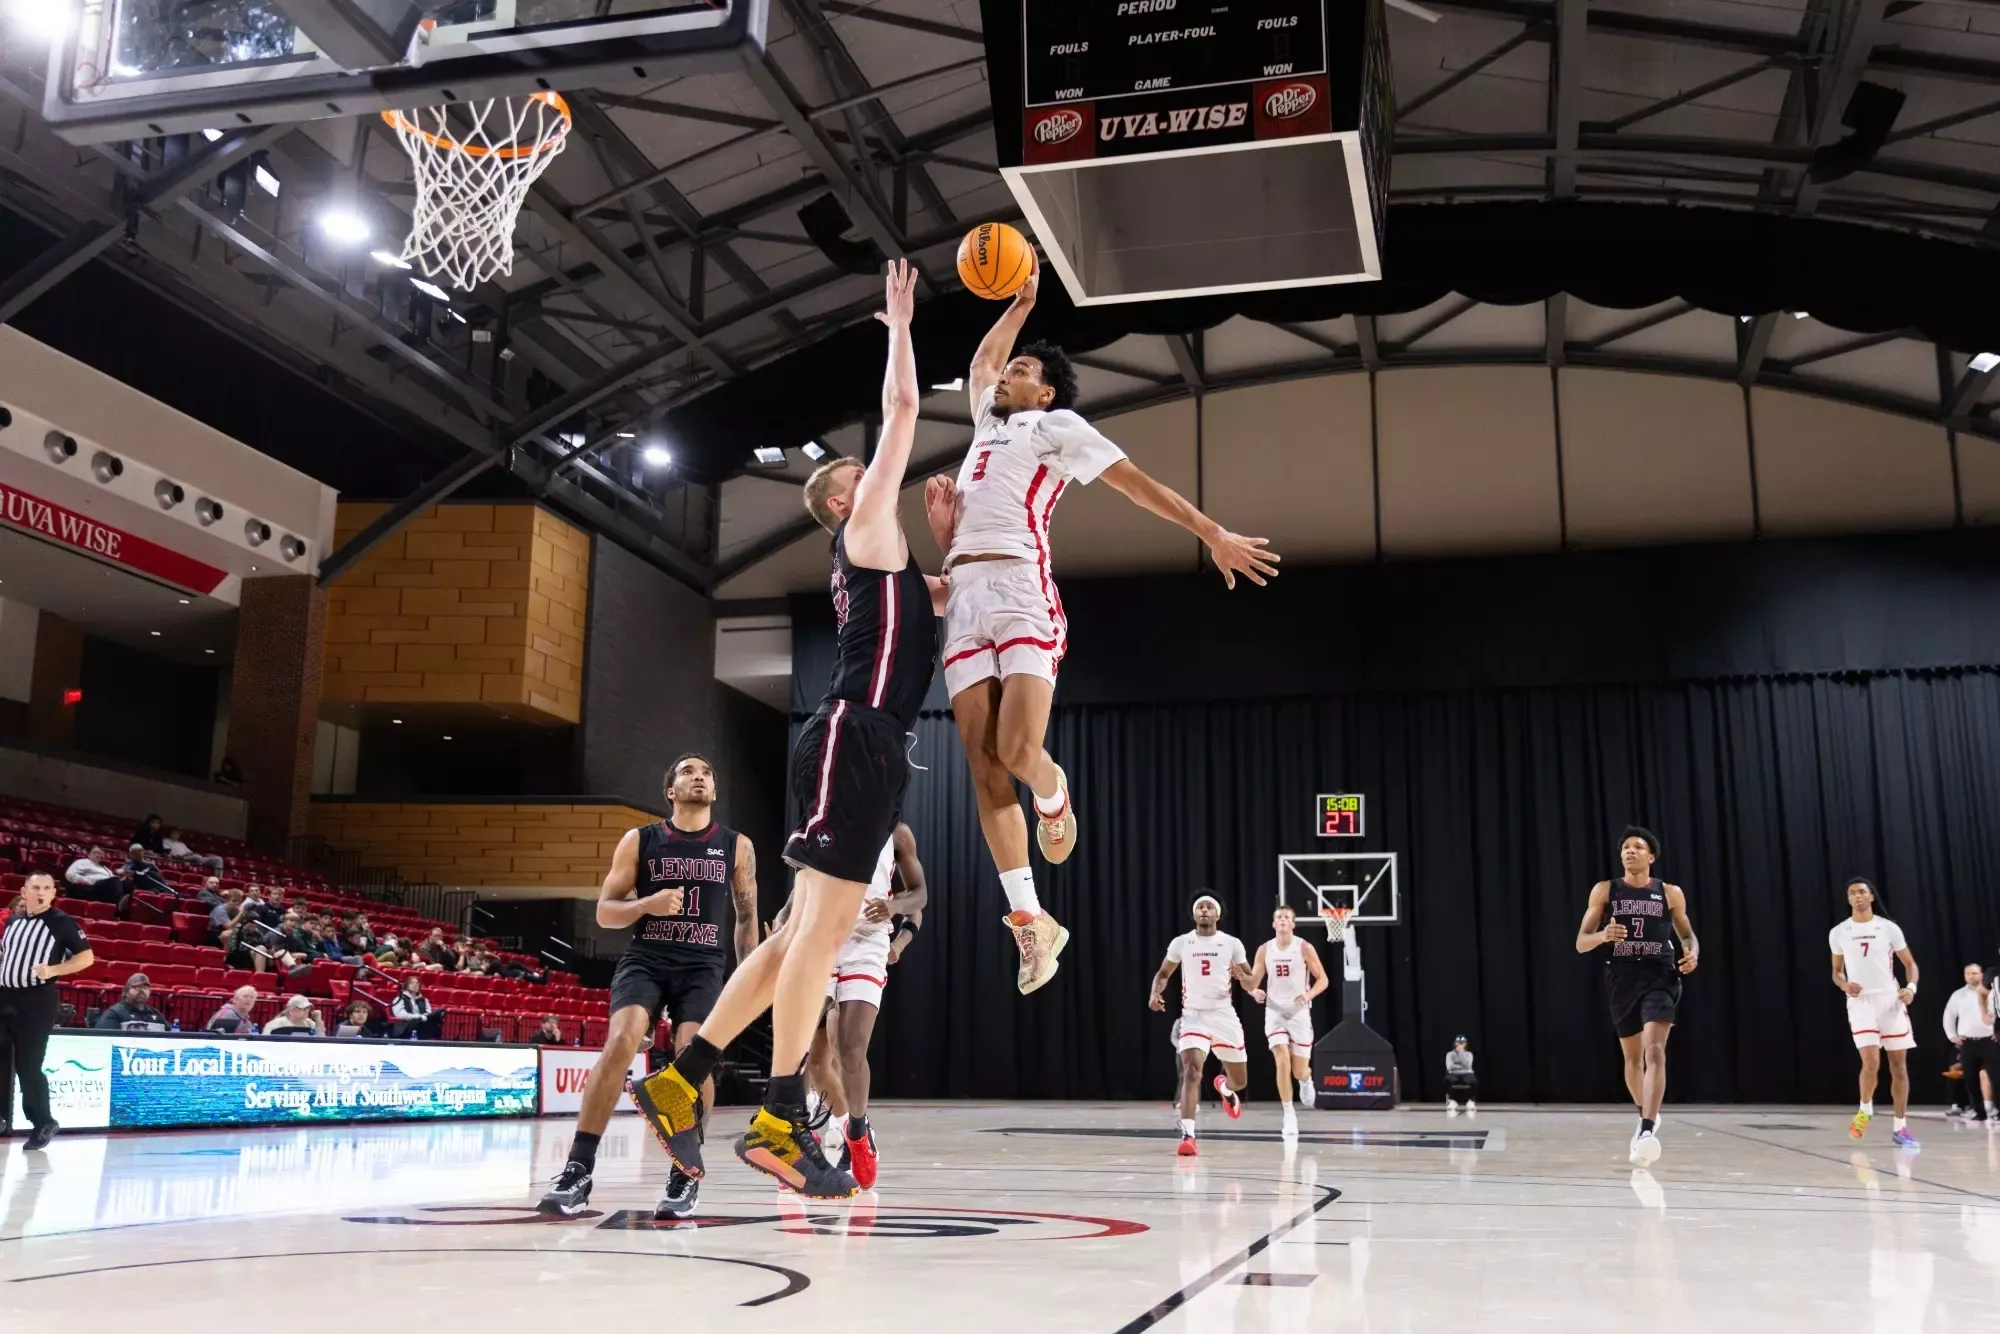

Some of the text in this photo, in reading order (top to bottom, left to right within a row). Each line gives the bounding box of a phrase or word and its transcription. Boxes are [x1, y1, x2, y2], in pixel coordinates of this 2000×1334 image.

[1117, 0, 1177, 16] PERIOD
[1257, 16, 1298, 30] FOULS
[1128, 26, 1217, 46] PLAYER-FOUL
[1049, 41, 1089, 56] FOULS
[1263, 63, 1293, 76] WON
[1134, 77, 1172, 91] GAME
[1055, 87, 1084, 100] WON
[1283, 87, 1301, 101] Dr
[1271, 91, 1312, 117] Pepper
[1051, 114, 1068, 128] Dr
[1100, 103, 1248, 141] UVA-WISE
[1040, 118, 1078, 143] Pepper
[971, 450, 992, 481] 3
[7, 491, 122, 560] UVA WISE
[1326, 797, 1358, 811] 15:08
[1326, 811, 1354, 833] 27
[707, 848, 725, 856] SAC
[648, 857, 726, 883] LENOIR
[1611, 899, 1664, 917] LENOIR
[642, 920, 719, 946] RHYNE
[1631, 917, 1645, 938] 7
[1860, 942, 1869, 957] 7
[1201, 960, 1211, 976] 2
[1276, 964, 1290, 976] 33
[118, 1047, 169, 1076] Your
[172, 1048, 226, 1076] Local
[245, 1082, 312, 1116] Serving
[313, 1082, 338, 1107] All
[341, 1081, 359, 1107] of
[359, 1083, 432, 1106] Southwest
[434, 1082, 488, 1112] Virginia
